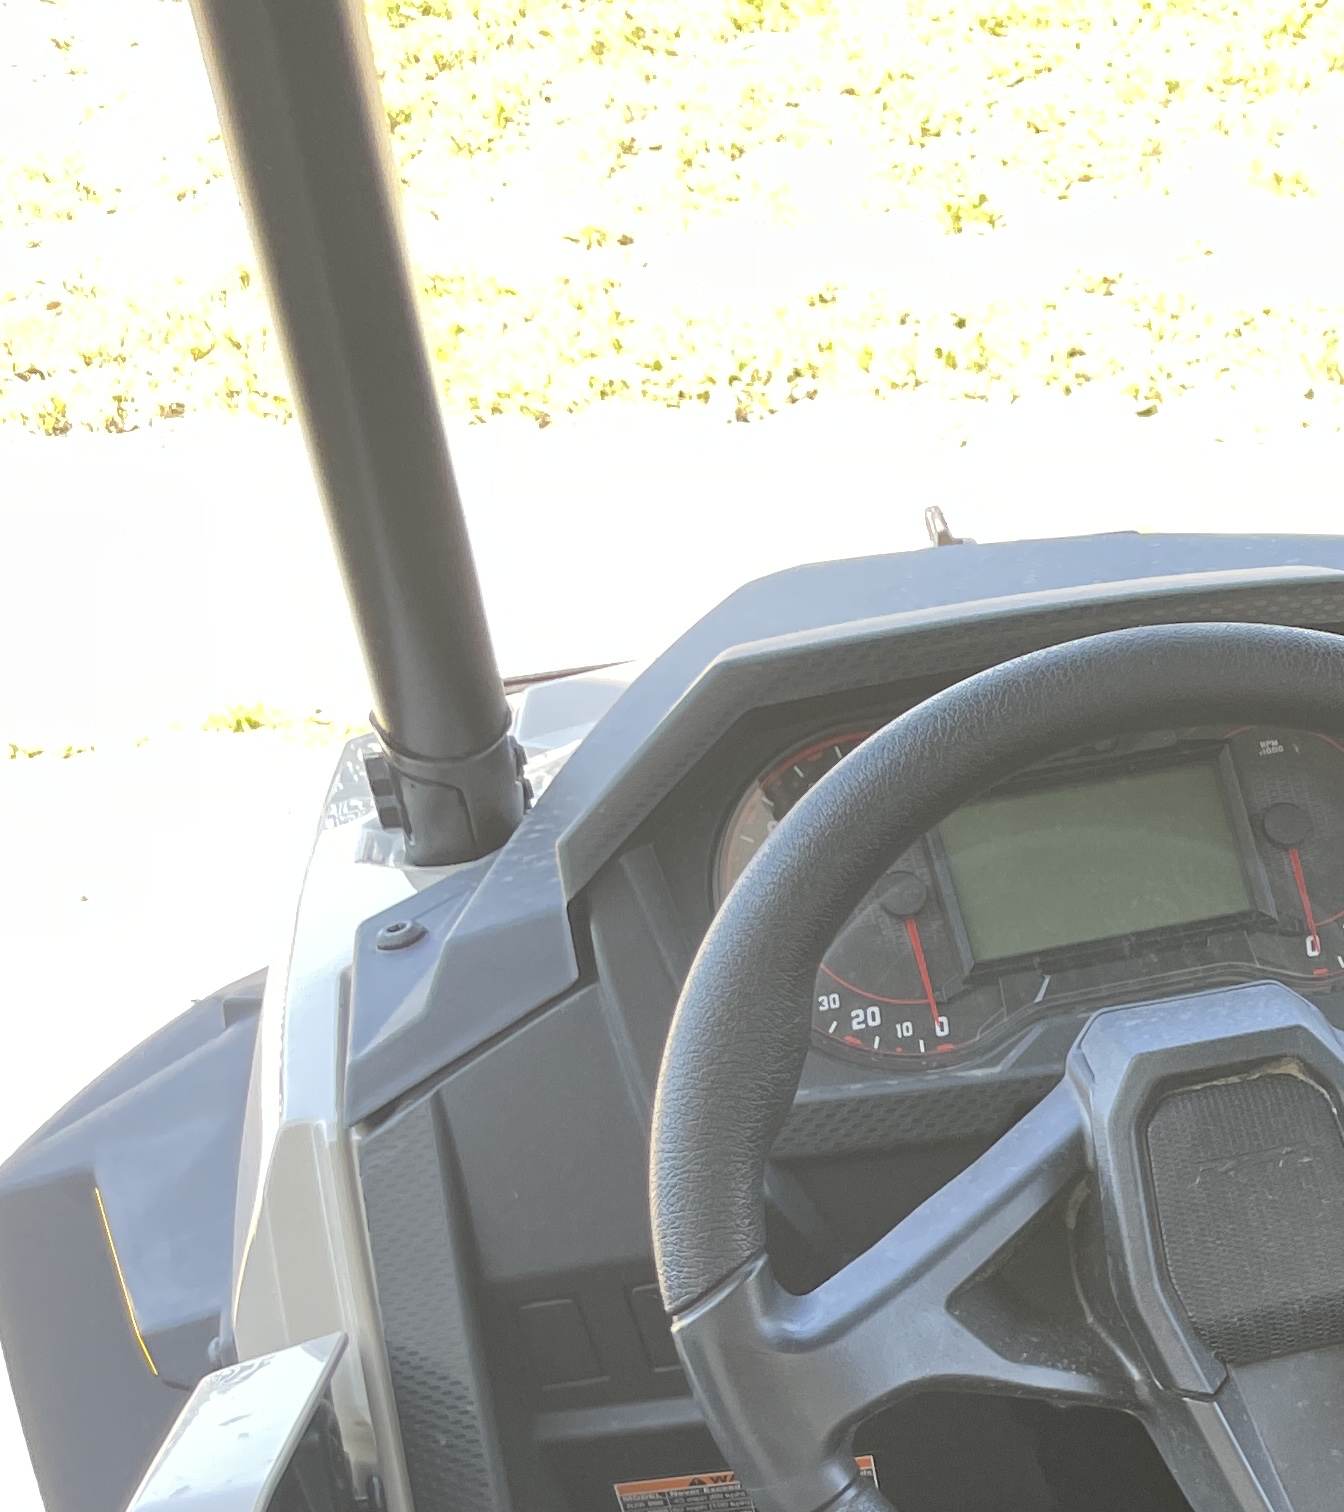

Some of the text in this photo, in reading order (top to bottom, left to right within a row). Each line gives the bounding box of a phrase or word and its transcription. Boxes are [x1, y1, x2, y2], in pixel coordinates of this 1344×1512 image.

[1306, 934, 1320, 957] 0
[818, 993, 840, 1011] 30
[851, 1006, 881, 1031] 20
[935, 1016, 950, 1037] 0
[896, 1021, 913, 1038] 10
